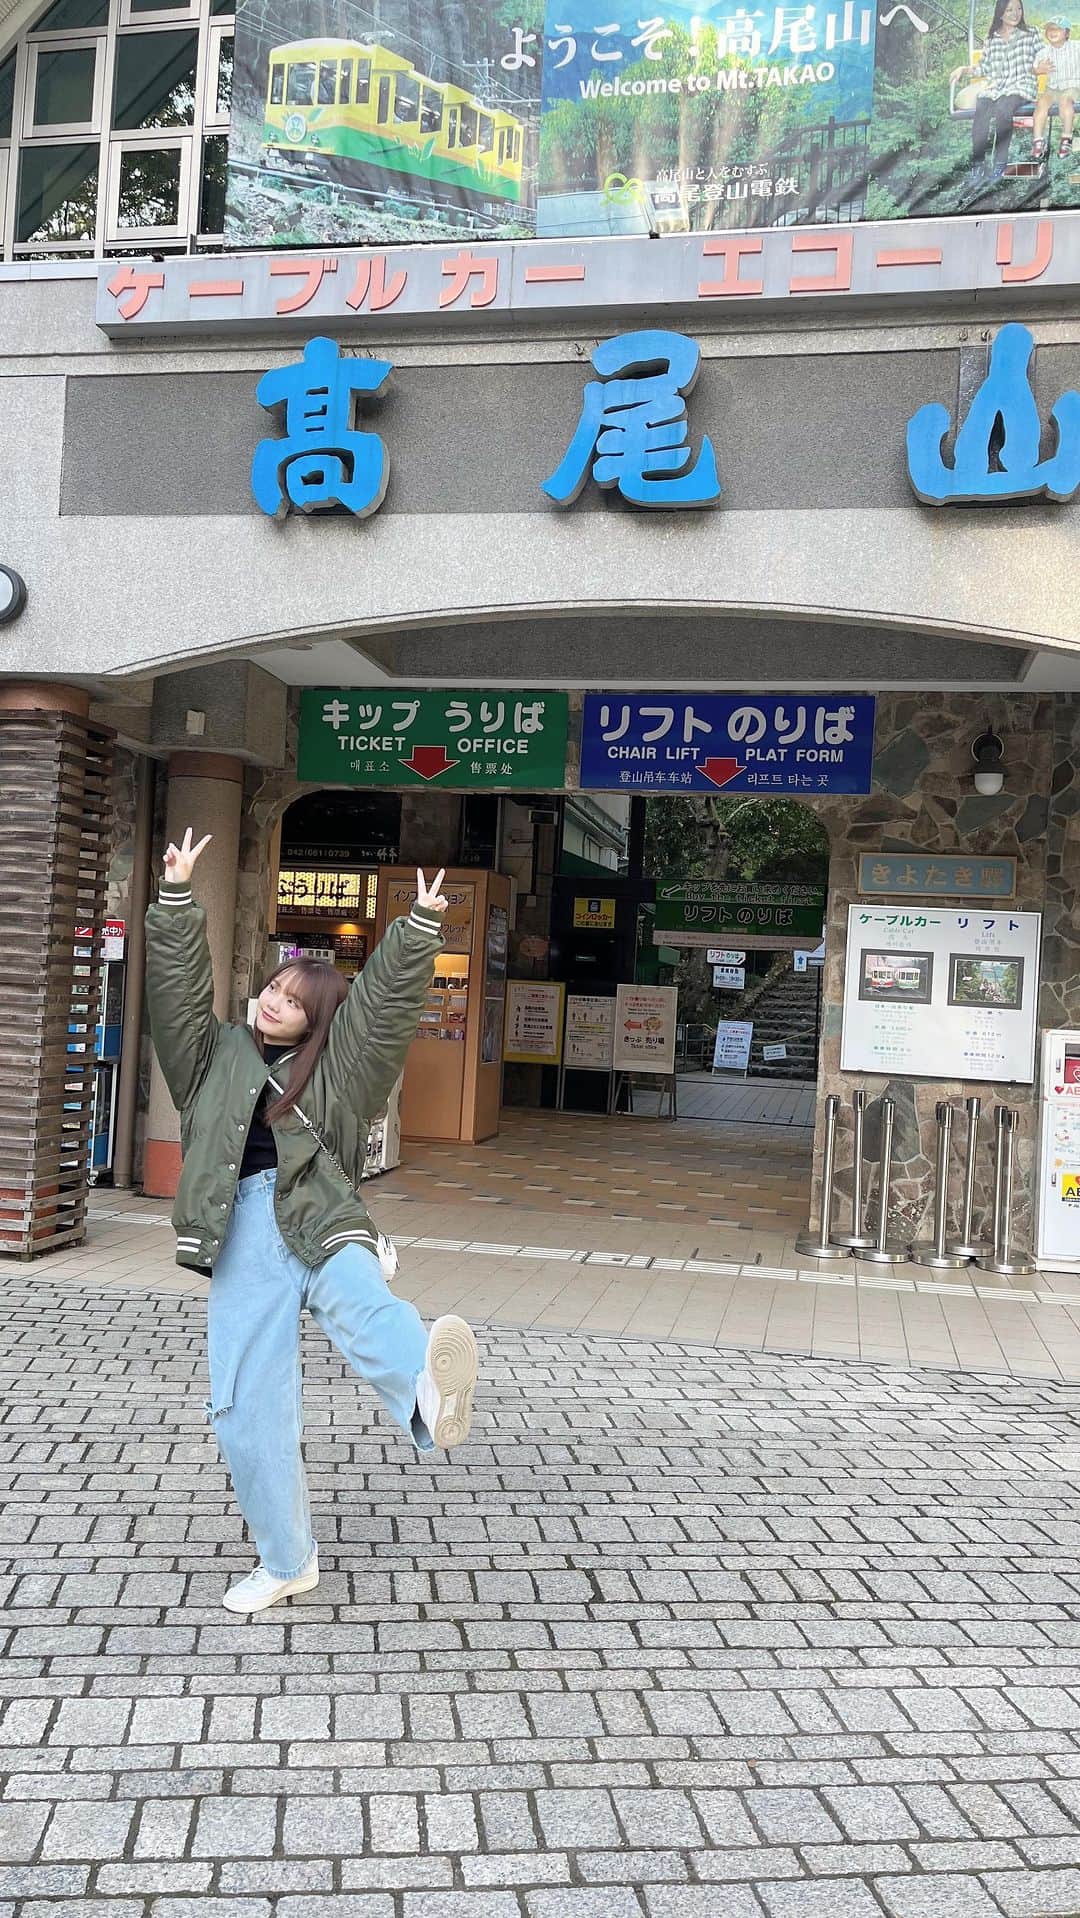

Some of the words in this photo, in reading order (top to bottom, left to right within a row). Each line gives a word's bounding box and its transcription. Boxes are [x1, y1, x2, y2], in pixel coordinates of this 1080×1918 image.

[579, 77, 682, 99] Welcome
[687, 75, 711, 92] to
[717, 62, 835, 90] Mt.TAKAO
[656, 162, 769, 183] 高尾山と人をむすぶ
[653, 177, 801, 203] 高尾登山電鉄
[107, 249, 586, 320] ケーブルカー
[698, 221, 1054, 297] エコーリ
[321, 699, 421, 731] キップ
[445, 701, 545, 733] うりば
[600, 705, 713, 744] リフト
[727, 706, 856, 745] のりば
[337, 735, 406, 752] TICKET
[457, 737, 529, 755] OFFICE
[607, 746, 657, 760] CHAIR
[666, 747, 701, 761] LIFT
[745, 748, 787, 762] PLAT
[796, 749, 844, 763] FORM
[618, 769, 693, 785] 登山吊车车站
[746, 772, 784, 787] 리프트
[787, 773, 813, 788] 타는
[817, 774, 830, 788] 곳
[684, 905, 732, 922] リフト
[737, 907, 793, 926] のりば
[859, 912, 941, 928] ケーブルカー
[957, 917, 1020, 932] リフト
